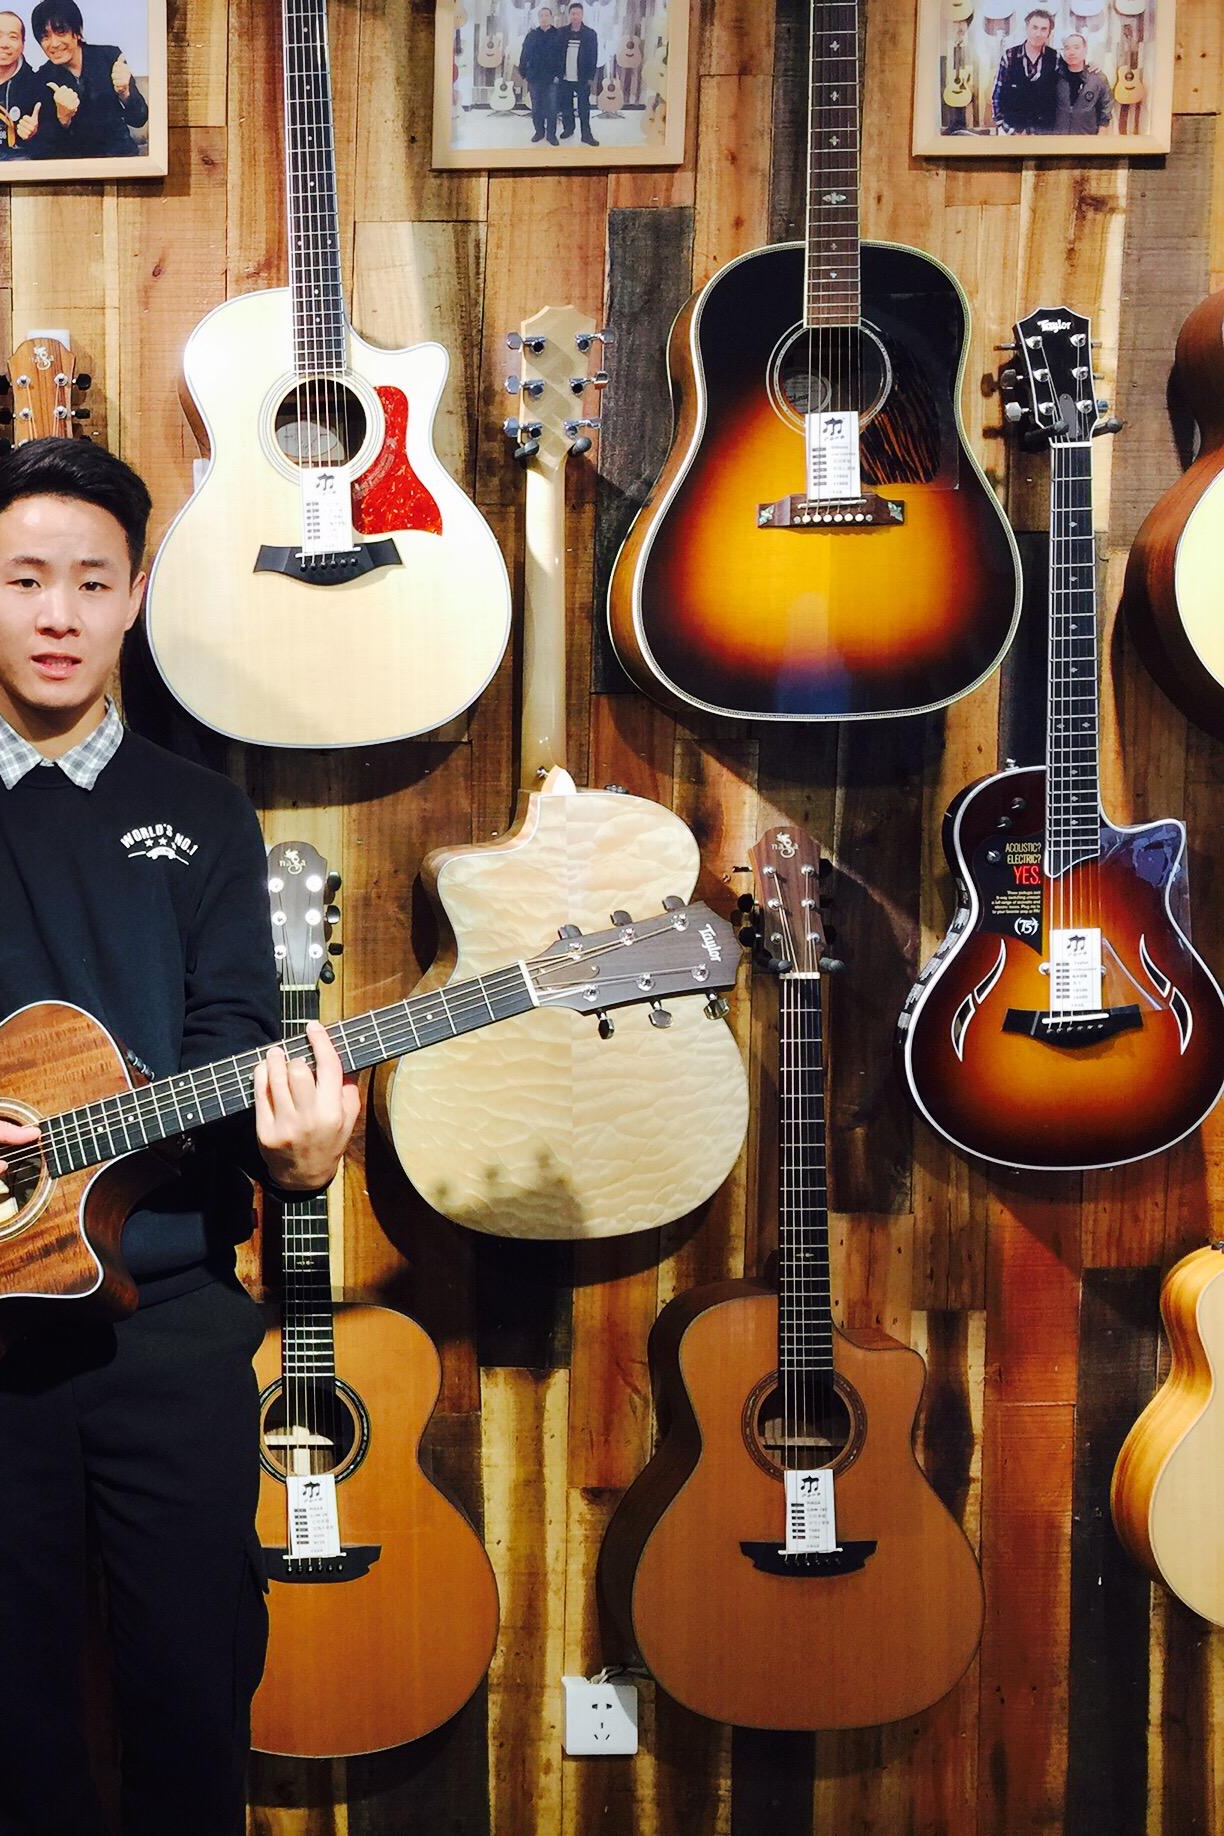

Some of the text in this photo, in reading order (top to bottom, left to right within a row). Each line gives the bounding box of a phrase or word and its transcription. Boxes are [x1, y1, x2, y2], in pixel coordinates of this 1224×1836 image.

[1036, 318, 1072, 333] Taylor
[120, 823, 198, 856] WORLD'S NO.1
[1005, 842, 1042, 853] ACOUSTIC?
[1007, 854, 1042, 865] ELECTRIC?
[1013, 865, 1041, 885] YES.
[697, 923, 722, 962] Taylor
